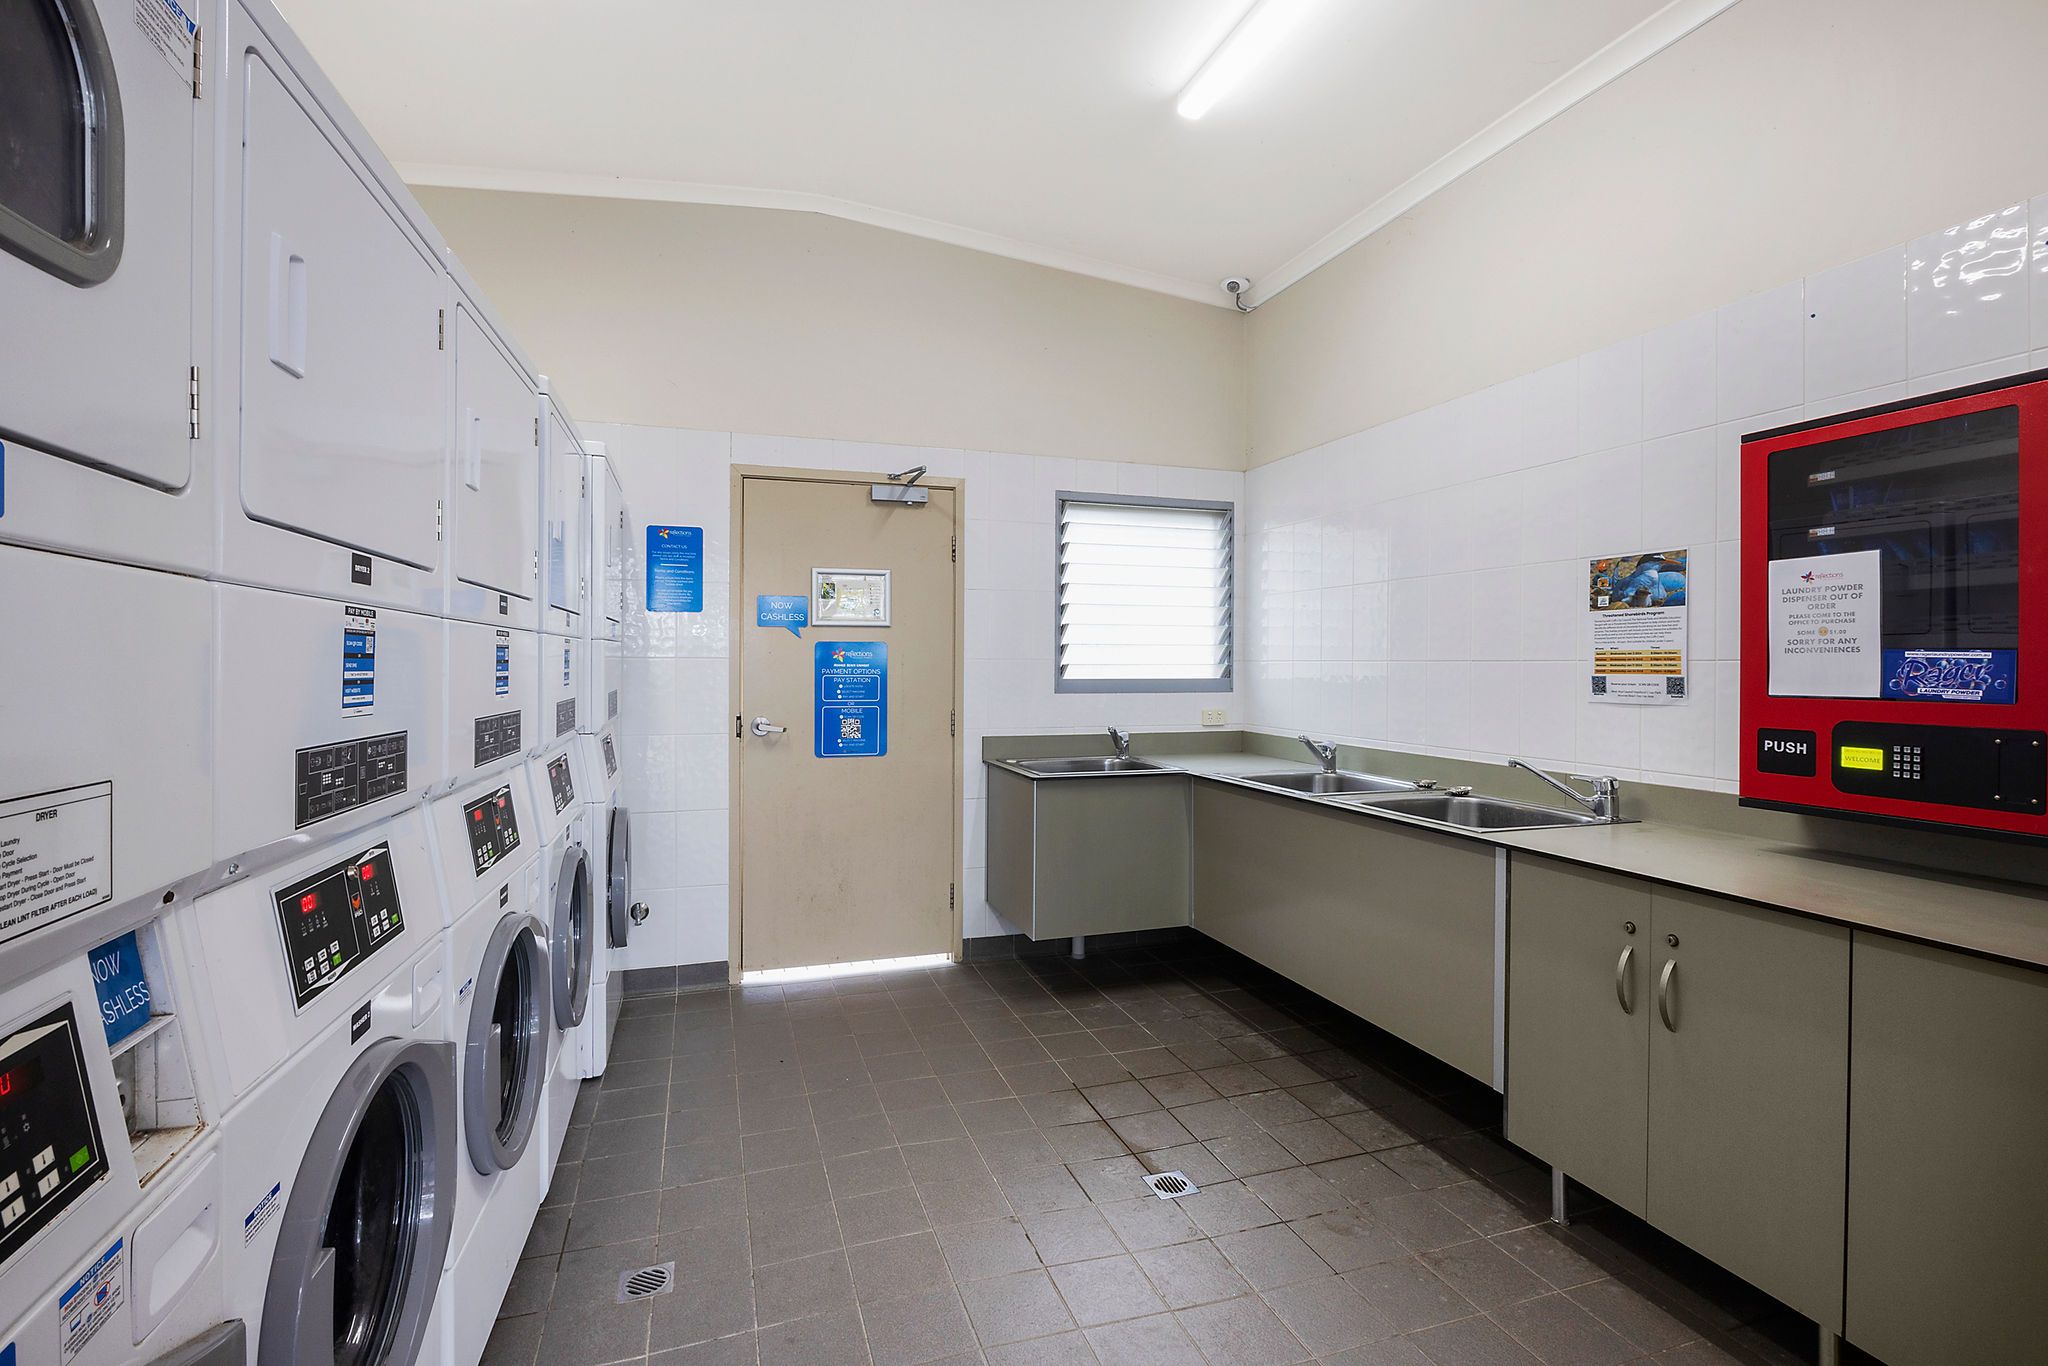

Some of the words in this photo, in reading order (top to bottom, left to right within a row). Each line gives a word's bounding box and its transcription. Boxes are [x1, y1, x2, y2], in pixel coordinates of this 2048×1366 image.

[1782, 586, 1822, 595] LAUNDRY
[1825, 584, 1864, 592] POWDER
[1782, 594, 1827, 603] DISPENSER
[760, 612, 805, 621] CASHLESS
[1899, 659, 1994, 689] Rager
[1764, 740, 1807, 754] PUSH
[36, 809, 58, 822] DRYER
[1, 838, 20, 848] Laundry
[2, 860, 15, 869] Cycle
[16, 854, 37, 864] Selection
[2, 868, 23, 878] Payment
[7, 880, 20, 888] Dryer
[25, 874, 37, 882] Press
[39, 870, 49, 878] Start
[81, 856, 95, 864] Closed
[7, 890, 20, 899] Dryer
[21, 885, 36, 894] During
[37, 880, 49, 888] Cycle
[14, 898, 26, 907] Dryer
[30, 893, 43, 901] Close
[44, 888, 54, 896] Door
[0, 918, 16, 929] LEAN
[17, 912, 30, 923] LINT
[31, 905, 49, 918] FILTER
[51, 899, 67, 910] AFTER
[68, 894, 82, 904] EACH
[83, 888, 98, 898] LOAD)
[92, 951, 120, 984] NOW
[254, 1192, 272, 1217] NOTICE
[80, 1256, 105, 1287] NOTICE
